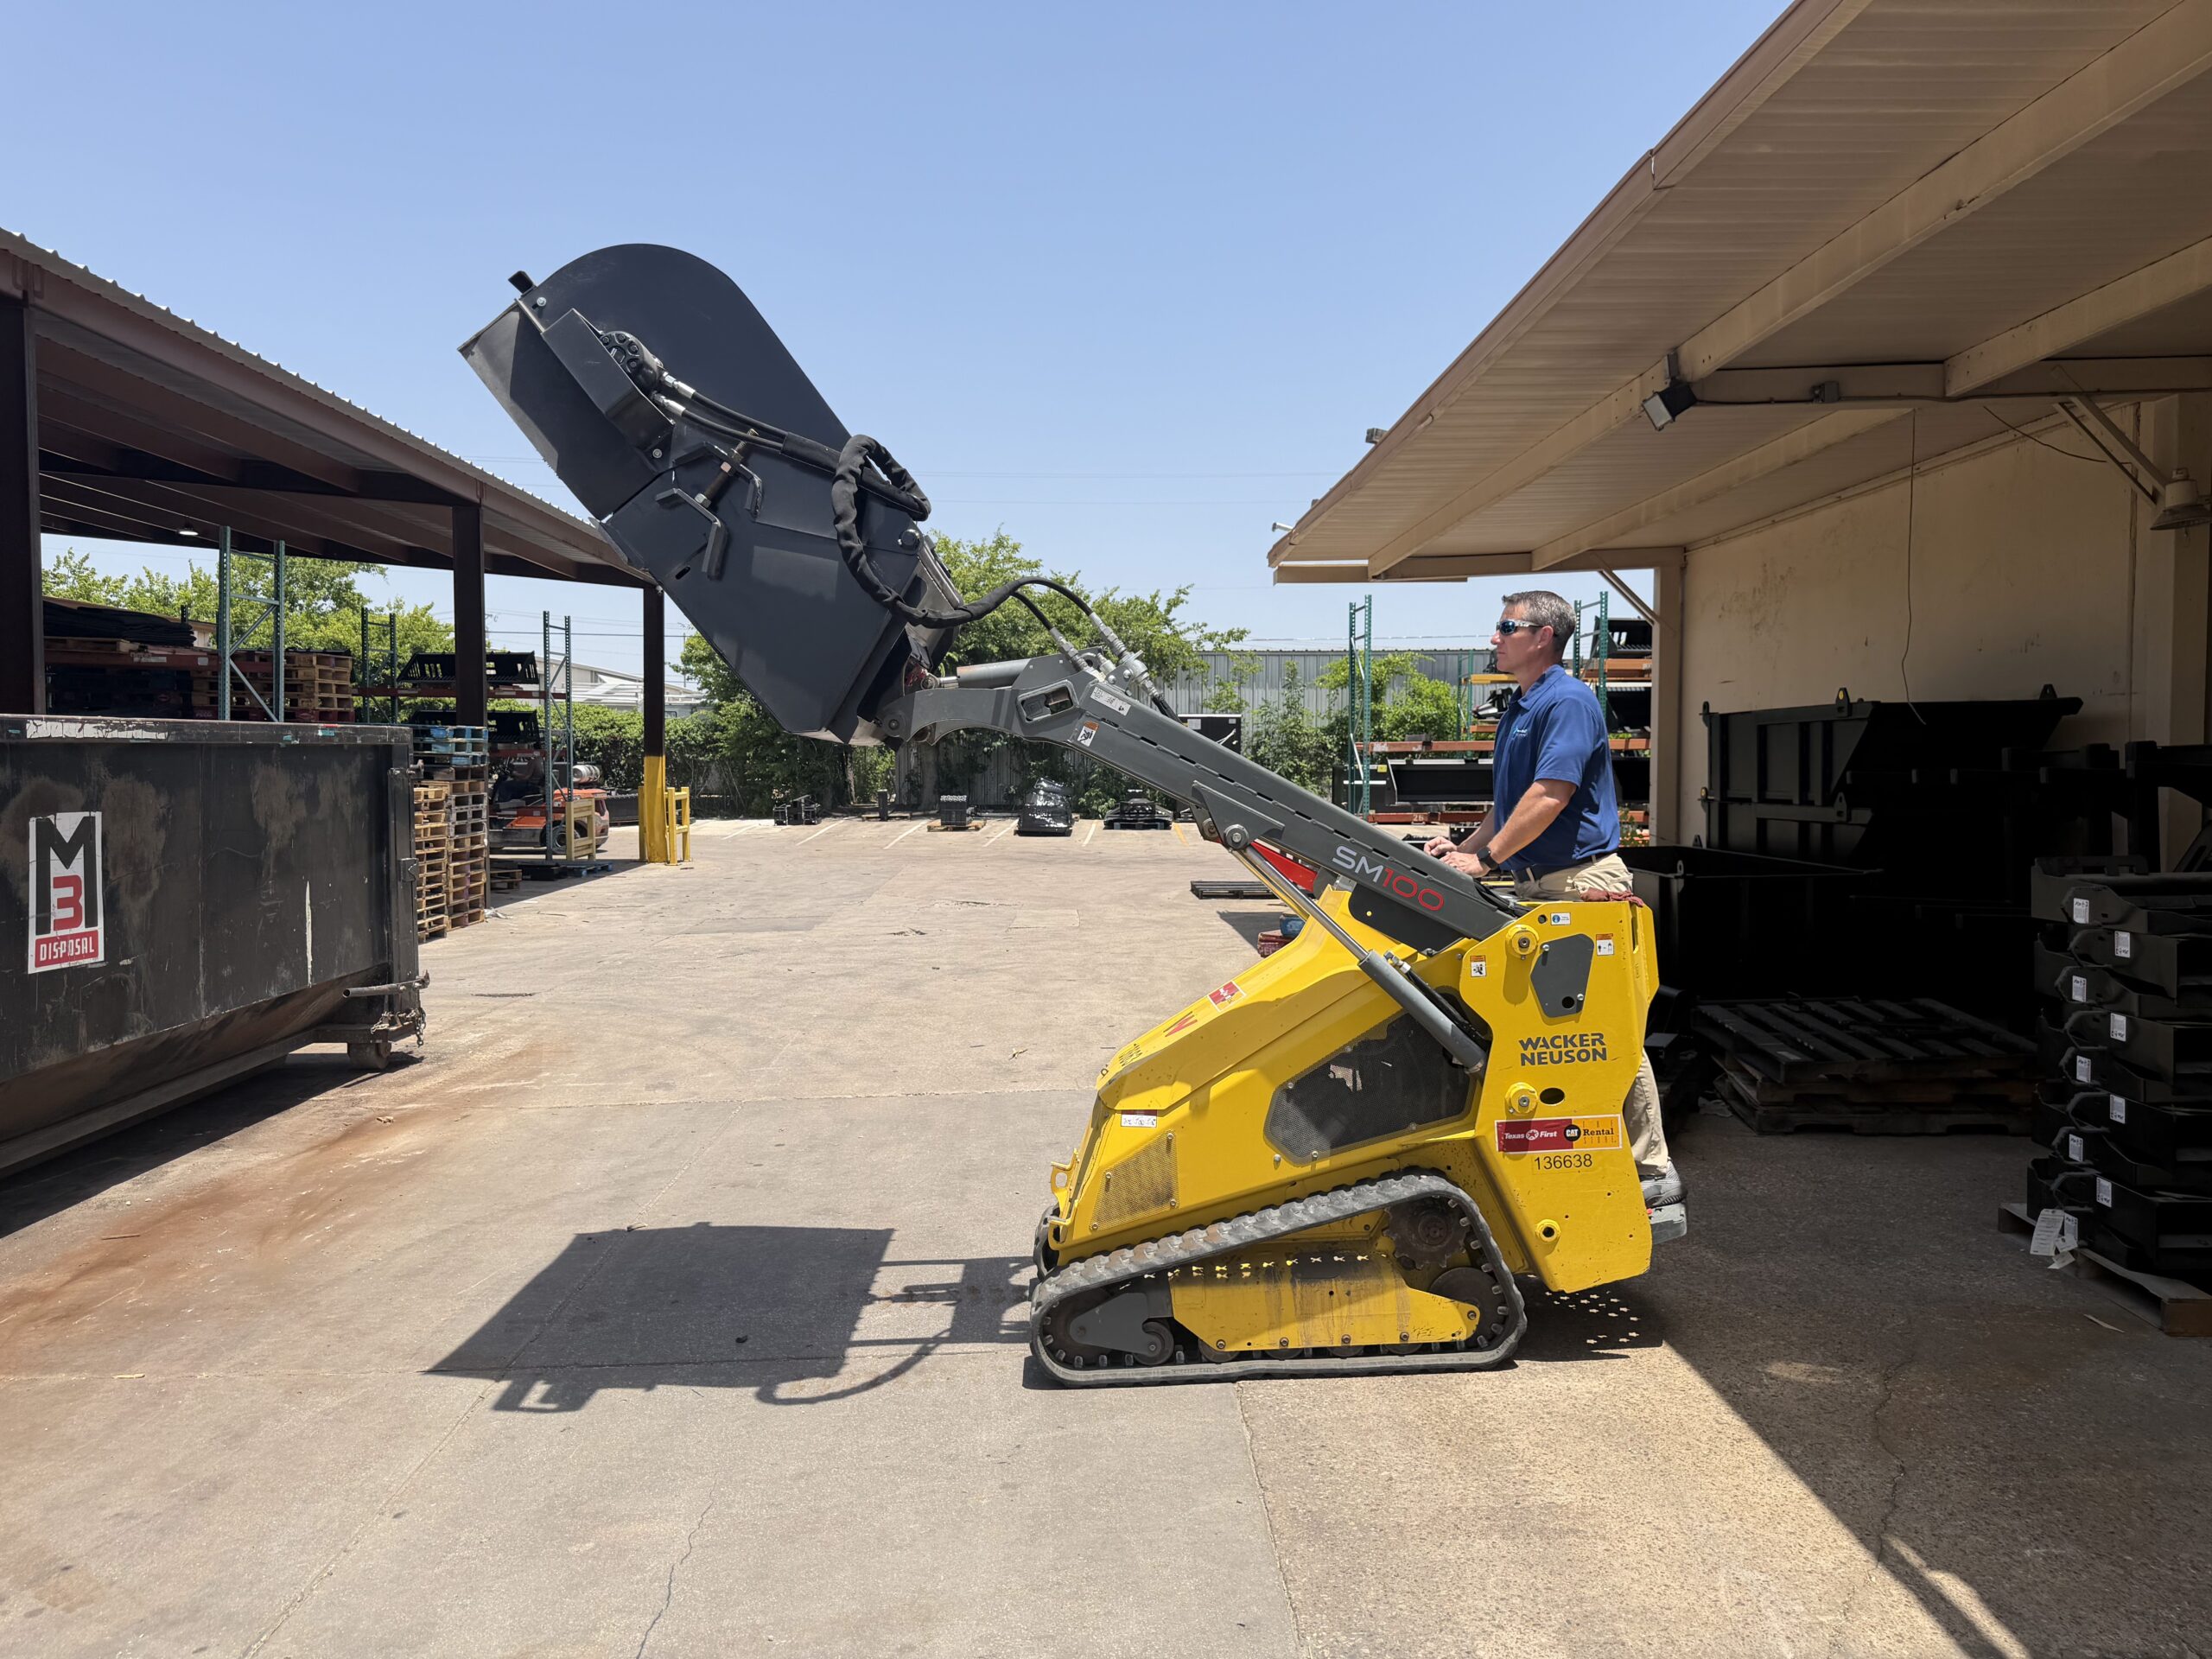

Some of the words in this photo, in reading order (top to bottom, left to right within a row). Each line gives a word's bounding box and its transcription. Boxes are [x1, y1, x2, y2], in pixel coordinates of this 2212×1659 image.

[1332, 845, 1445, 911] SM100
[40, 936, 94, 962] DISPOSAL
[1518, 1033, 1605, 1051] WACKER
[1521, 1047, 1607, 1066] NEUSON
[1566, 1128, 1579, 1137] CAT
[1583, 1128, 1614, 1136] Rental
[1534, 1154, 1592, 1170] 136638
